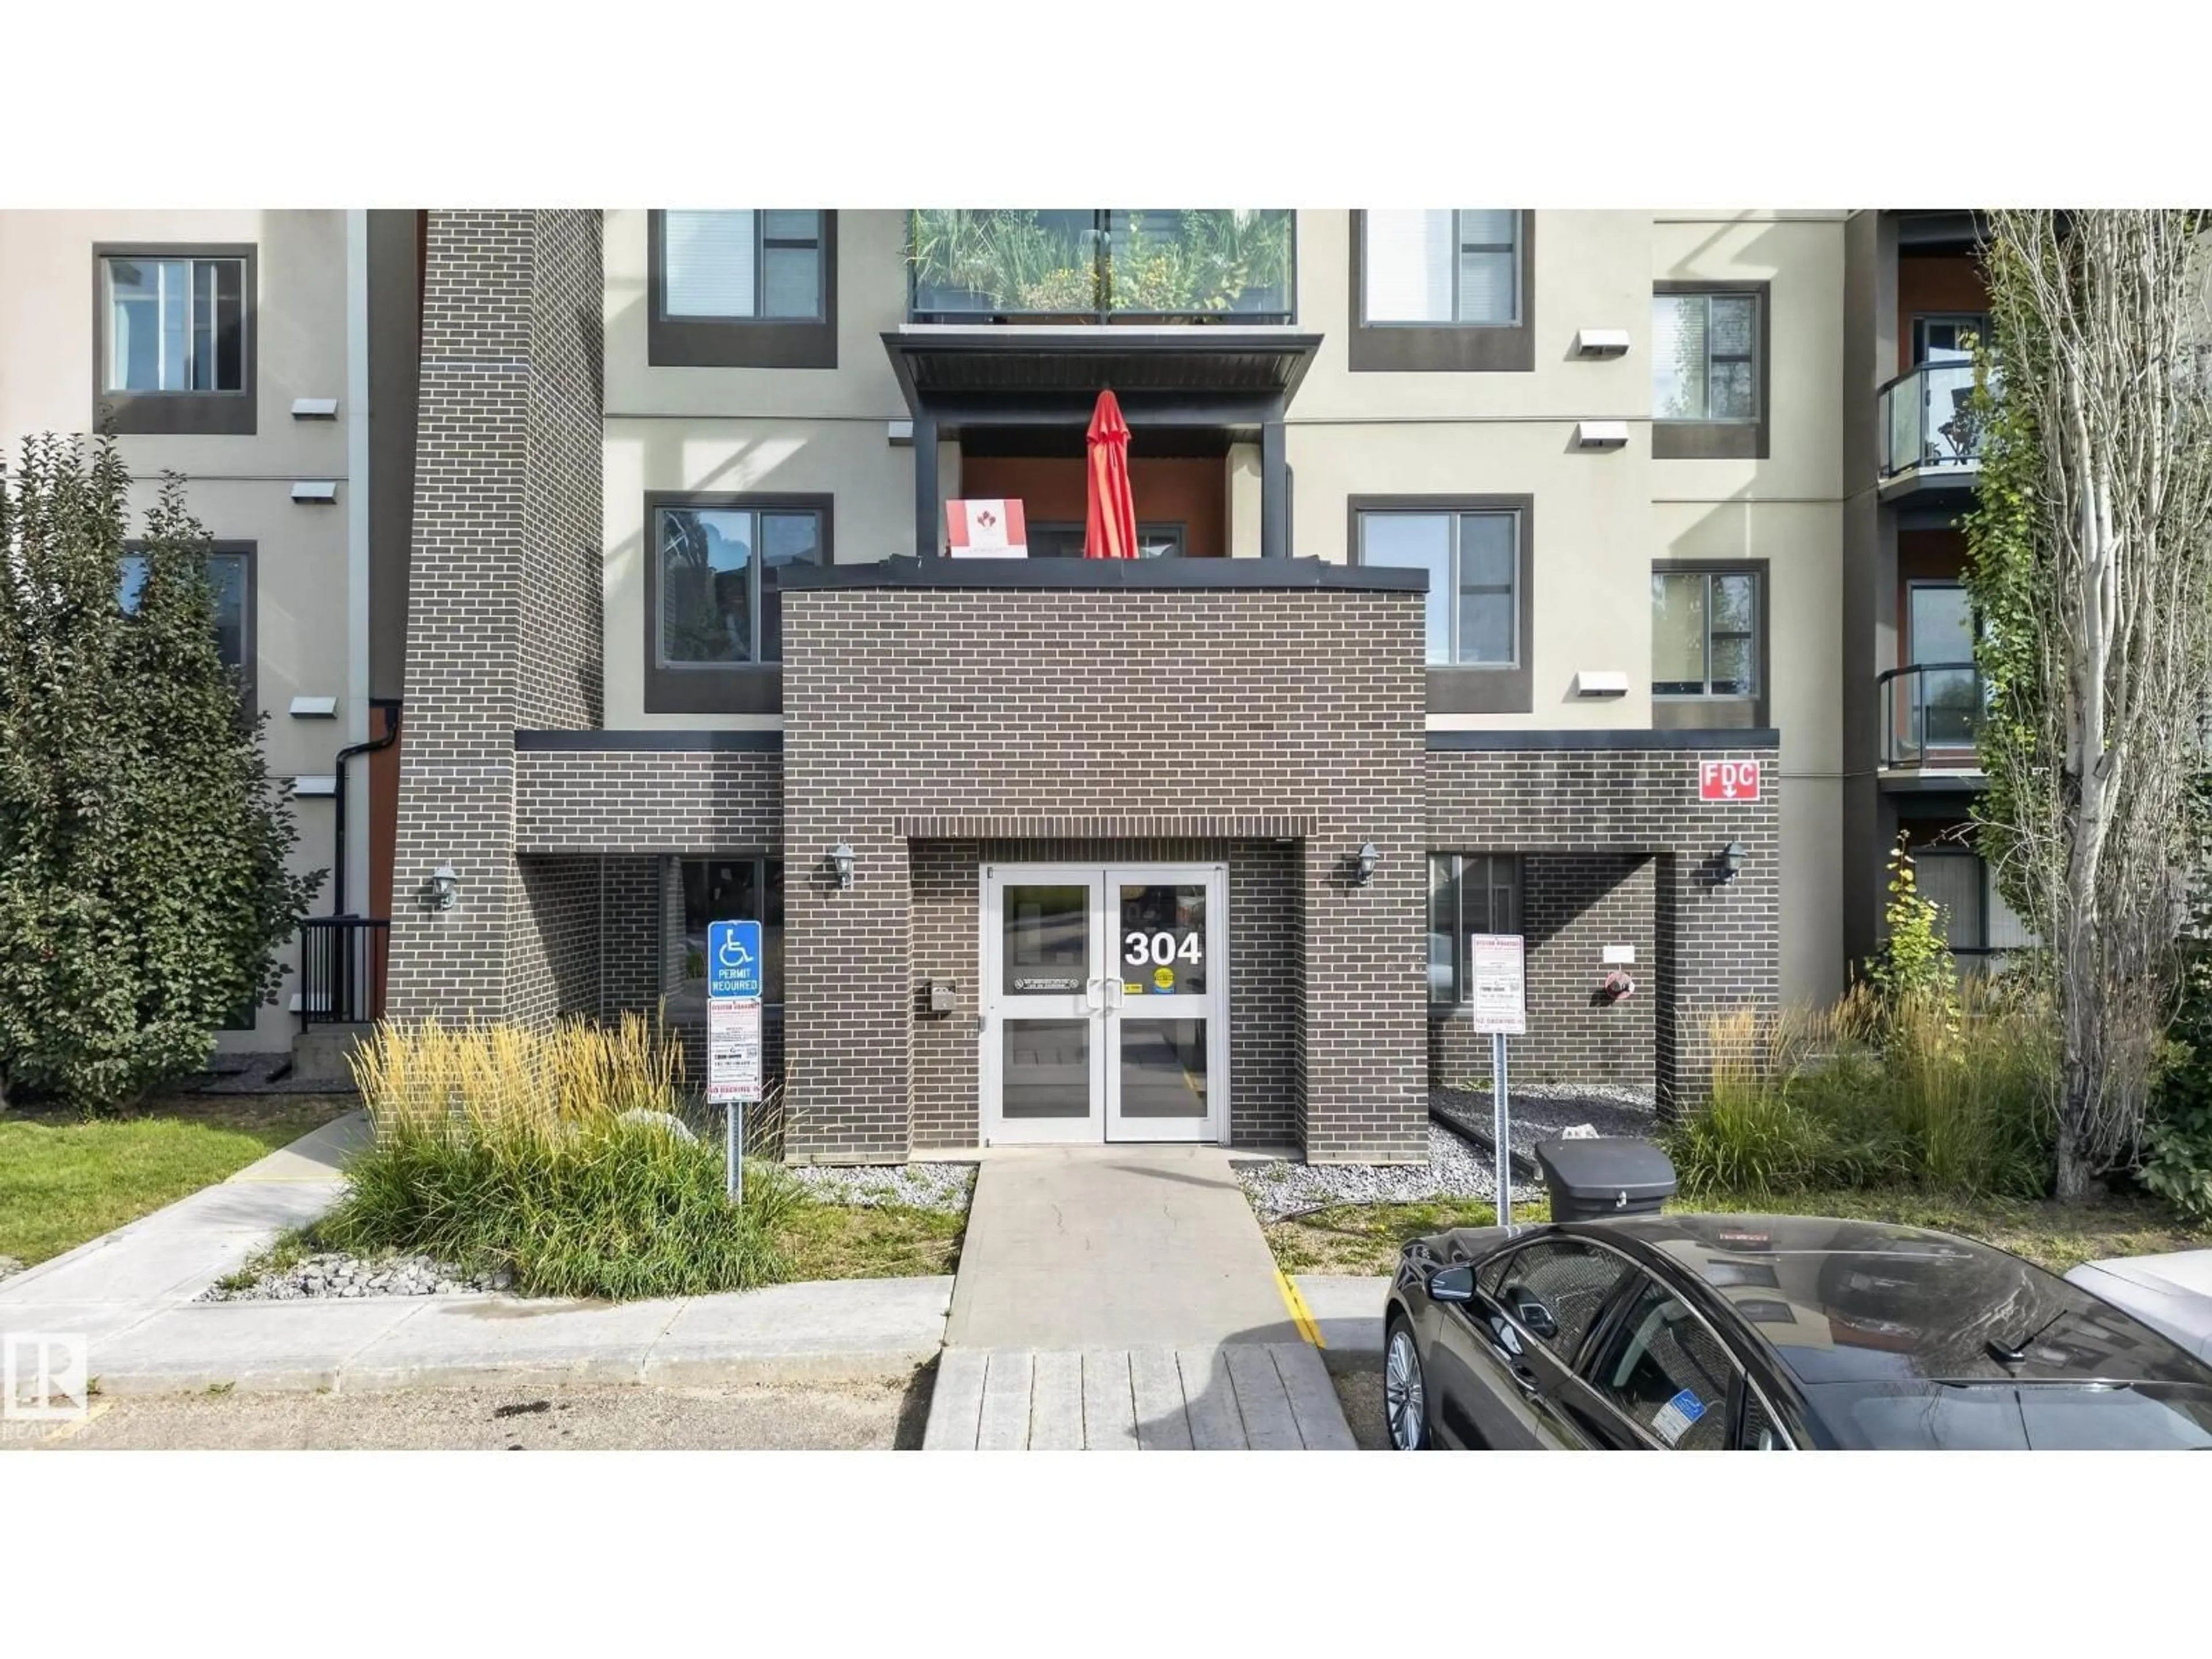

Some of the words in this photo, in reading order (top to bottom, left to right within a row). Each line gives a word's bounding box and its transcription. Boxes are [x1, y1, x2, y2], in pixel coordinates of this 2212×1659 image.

[1705, 763, 1754, 786] FDC
[1125, 931, 1202, 965] 304
[718, 968, 751, 979] PERMIT
[712, 980, 757, 991] REQUIRED
